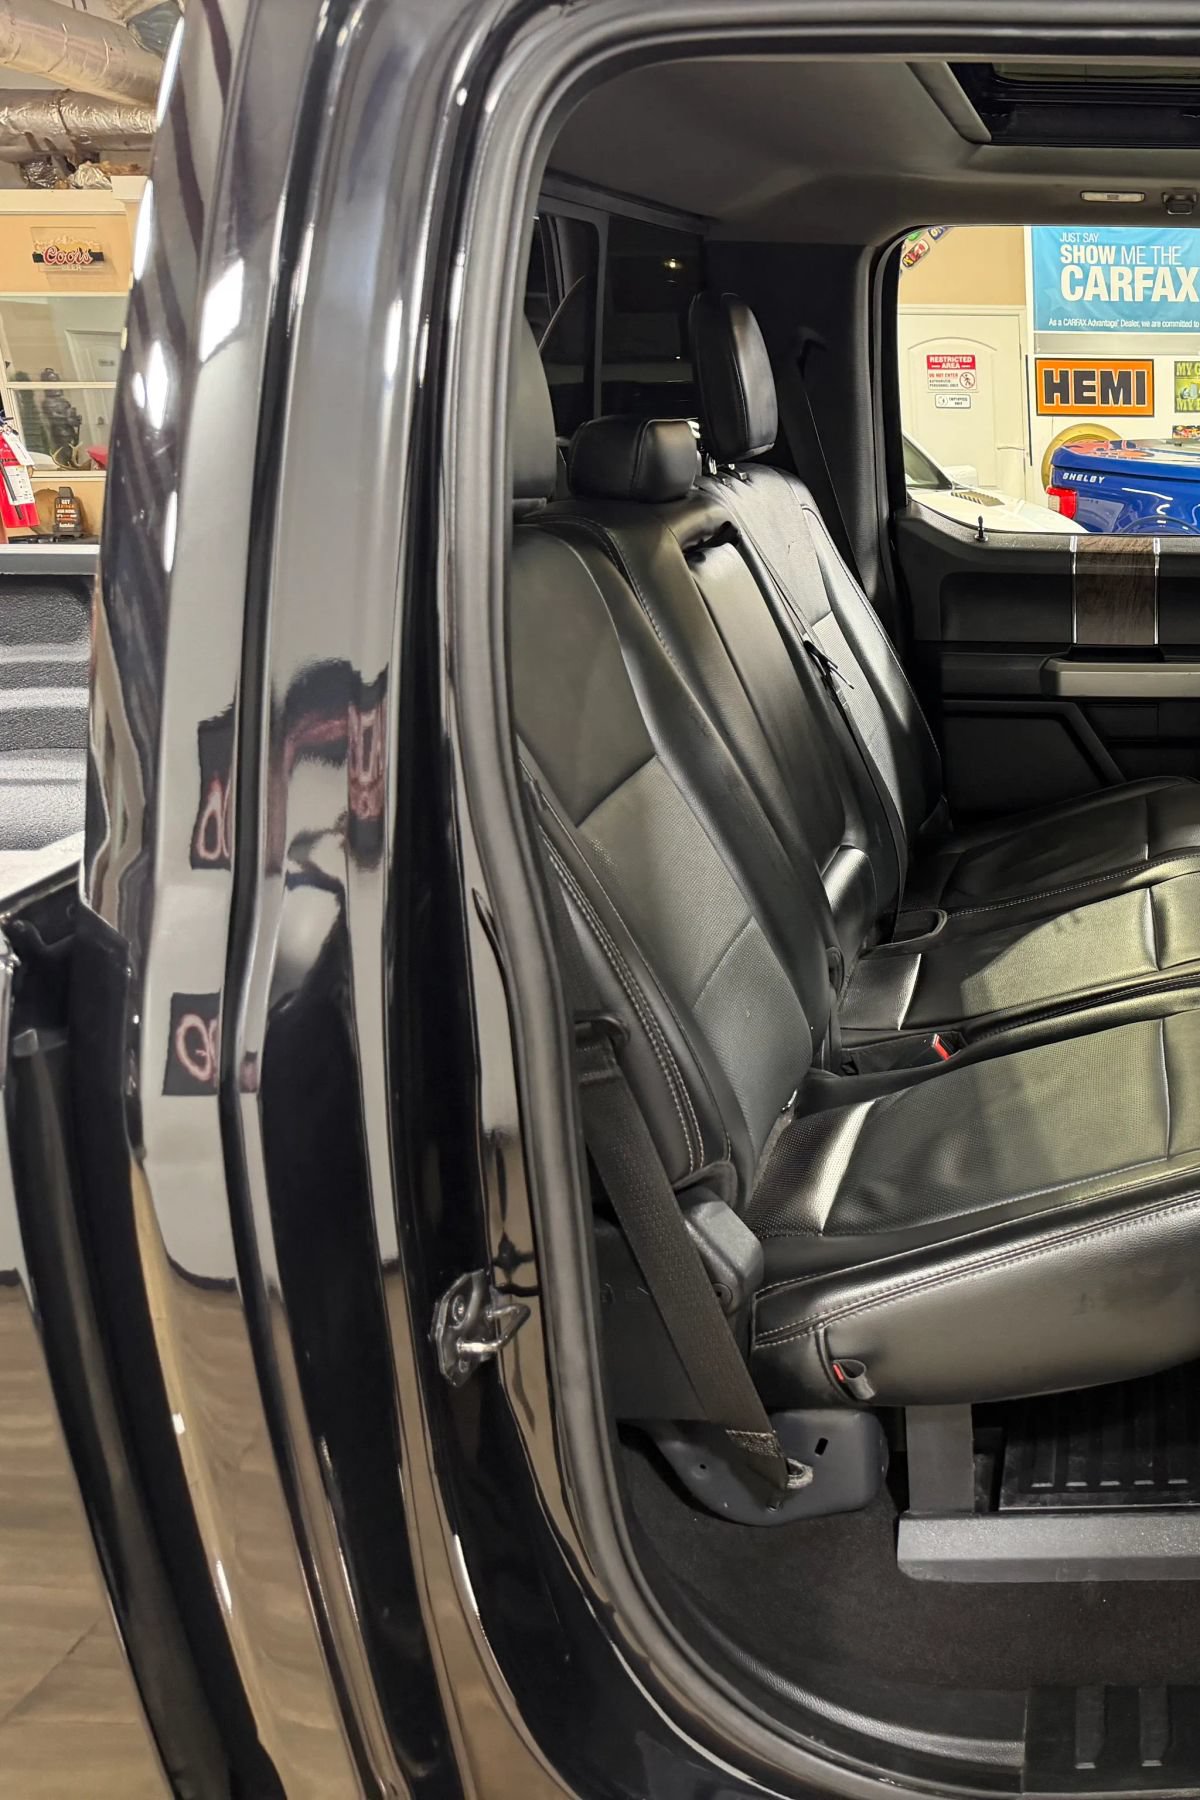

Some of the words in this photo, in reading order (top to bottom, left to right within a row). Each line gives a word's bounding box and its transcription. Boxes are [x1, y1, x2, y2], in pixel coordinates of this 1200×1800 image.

[1060, 232, 1081, 243] JUST
[1083, 232, 1099, 243] SAY
[44, 245, 93, 265] Coors
[1060, 244, 1116, 265] SHOW
[1121, 245, 1146, 265] ME
[1150, 245, 1182, 265] THE
[1060, 265, 1200, 302] CARFAX
[1048, 318, 1056, 326] As
[1063, 318, 1087, 327] CARFAX
[1120, 319, 1140, 328] Dealer,
[1162, 319, 1193, 328] committed
[1194, 320, 1200, 328] to
[1176, 362, 1193, 376] MY
[1042, 367, 1147, 407] HEMI
[1176, 398, 1194, 411] MY
[1062, 472, 1105, 484] SHELBY
